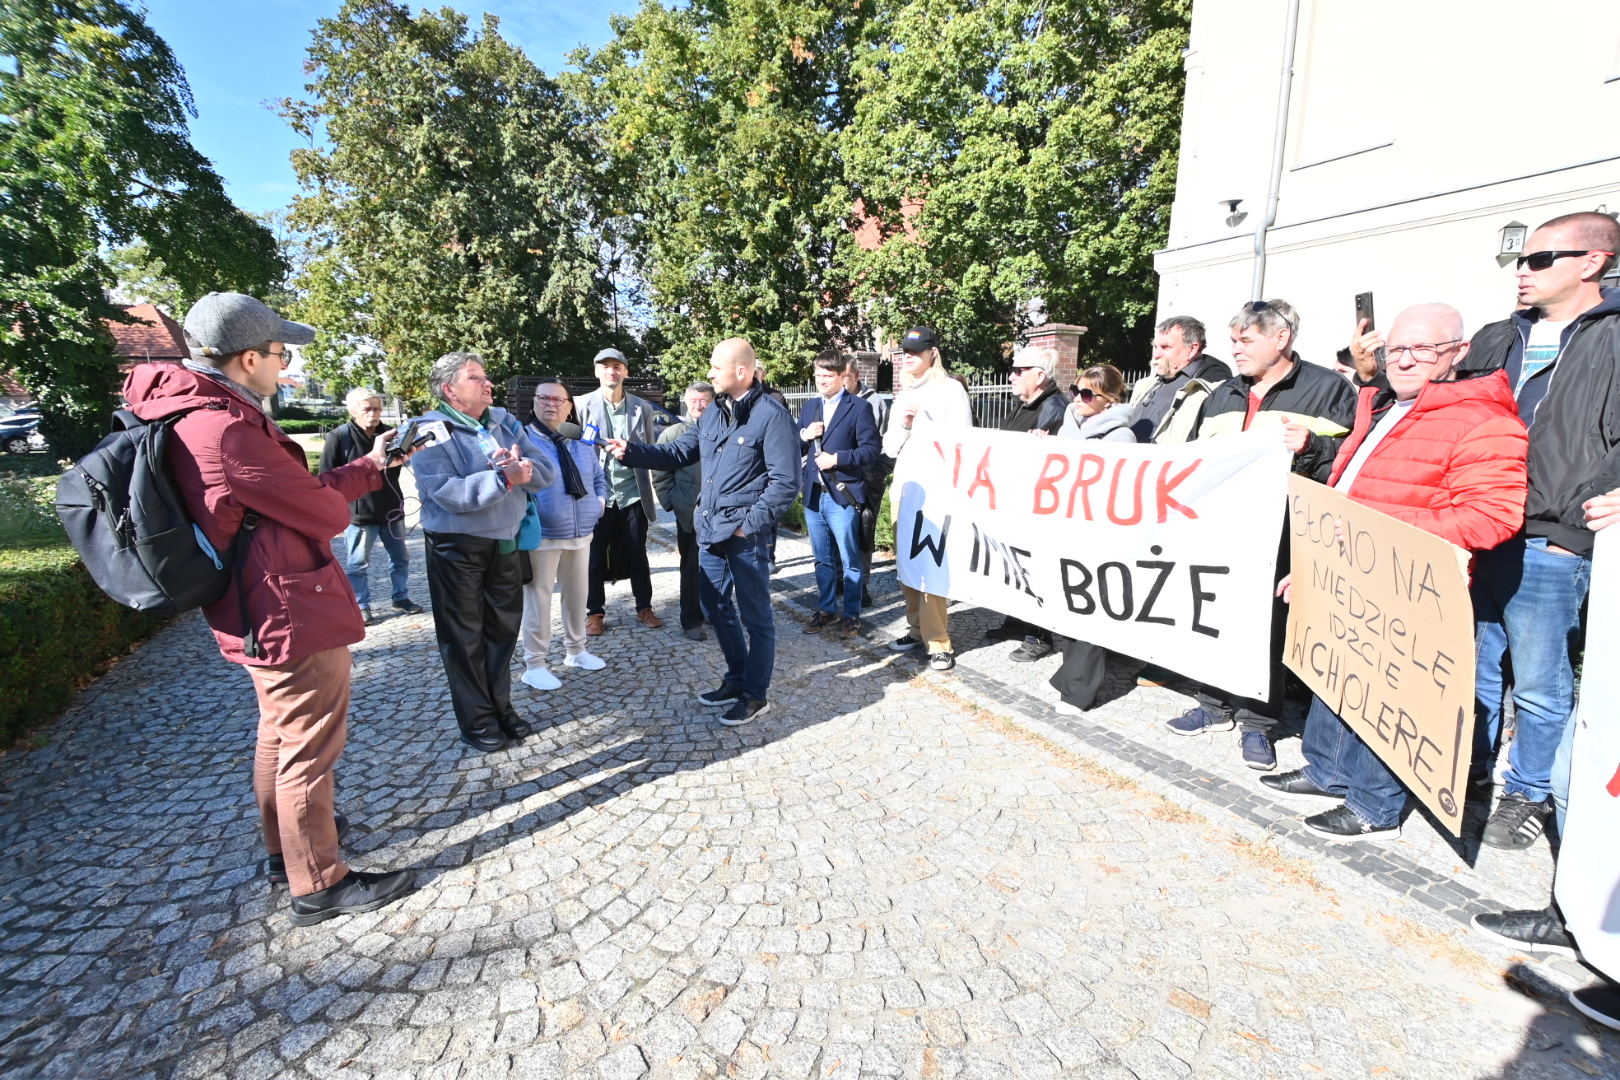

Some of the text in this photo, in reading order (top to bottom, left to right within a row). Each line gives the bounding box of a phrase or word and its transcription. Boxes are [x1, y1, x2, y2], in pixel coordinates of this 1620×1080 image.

[1032, 453, 1203, 526] BRUK
[910, 510, 952, 568] W
[1060, 544, 1230, 639] BOŻE
[1393, 545, 1444, 622] NA
